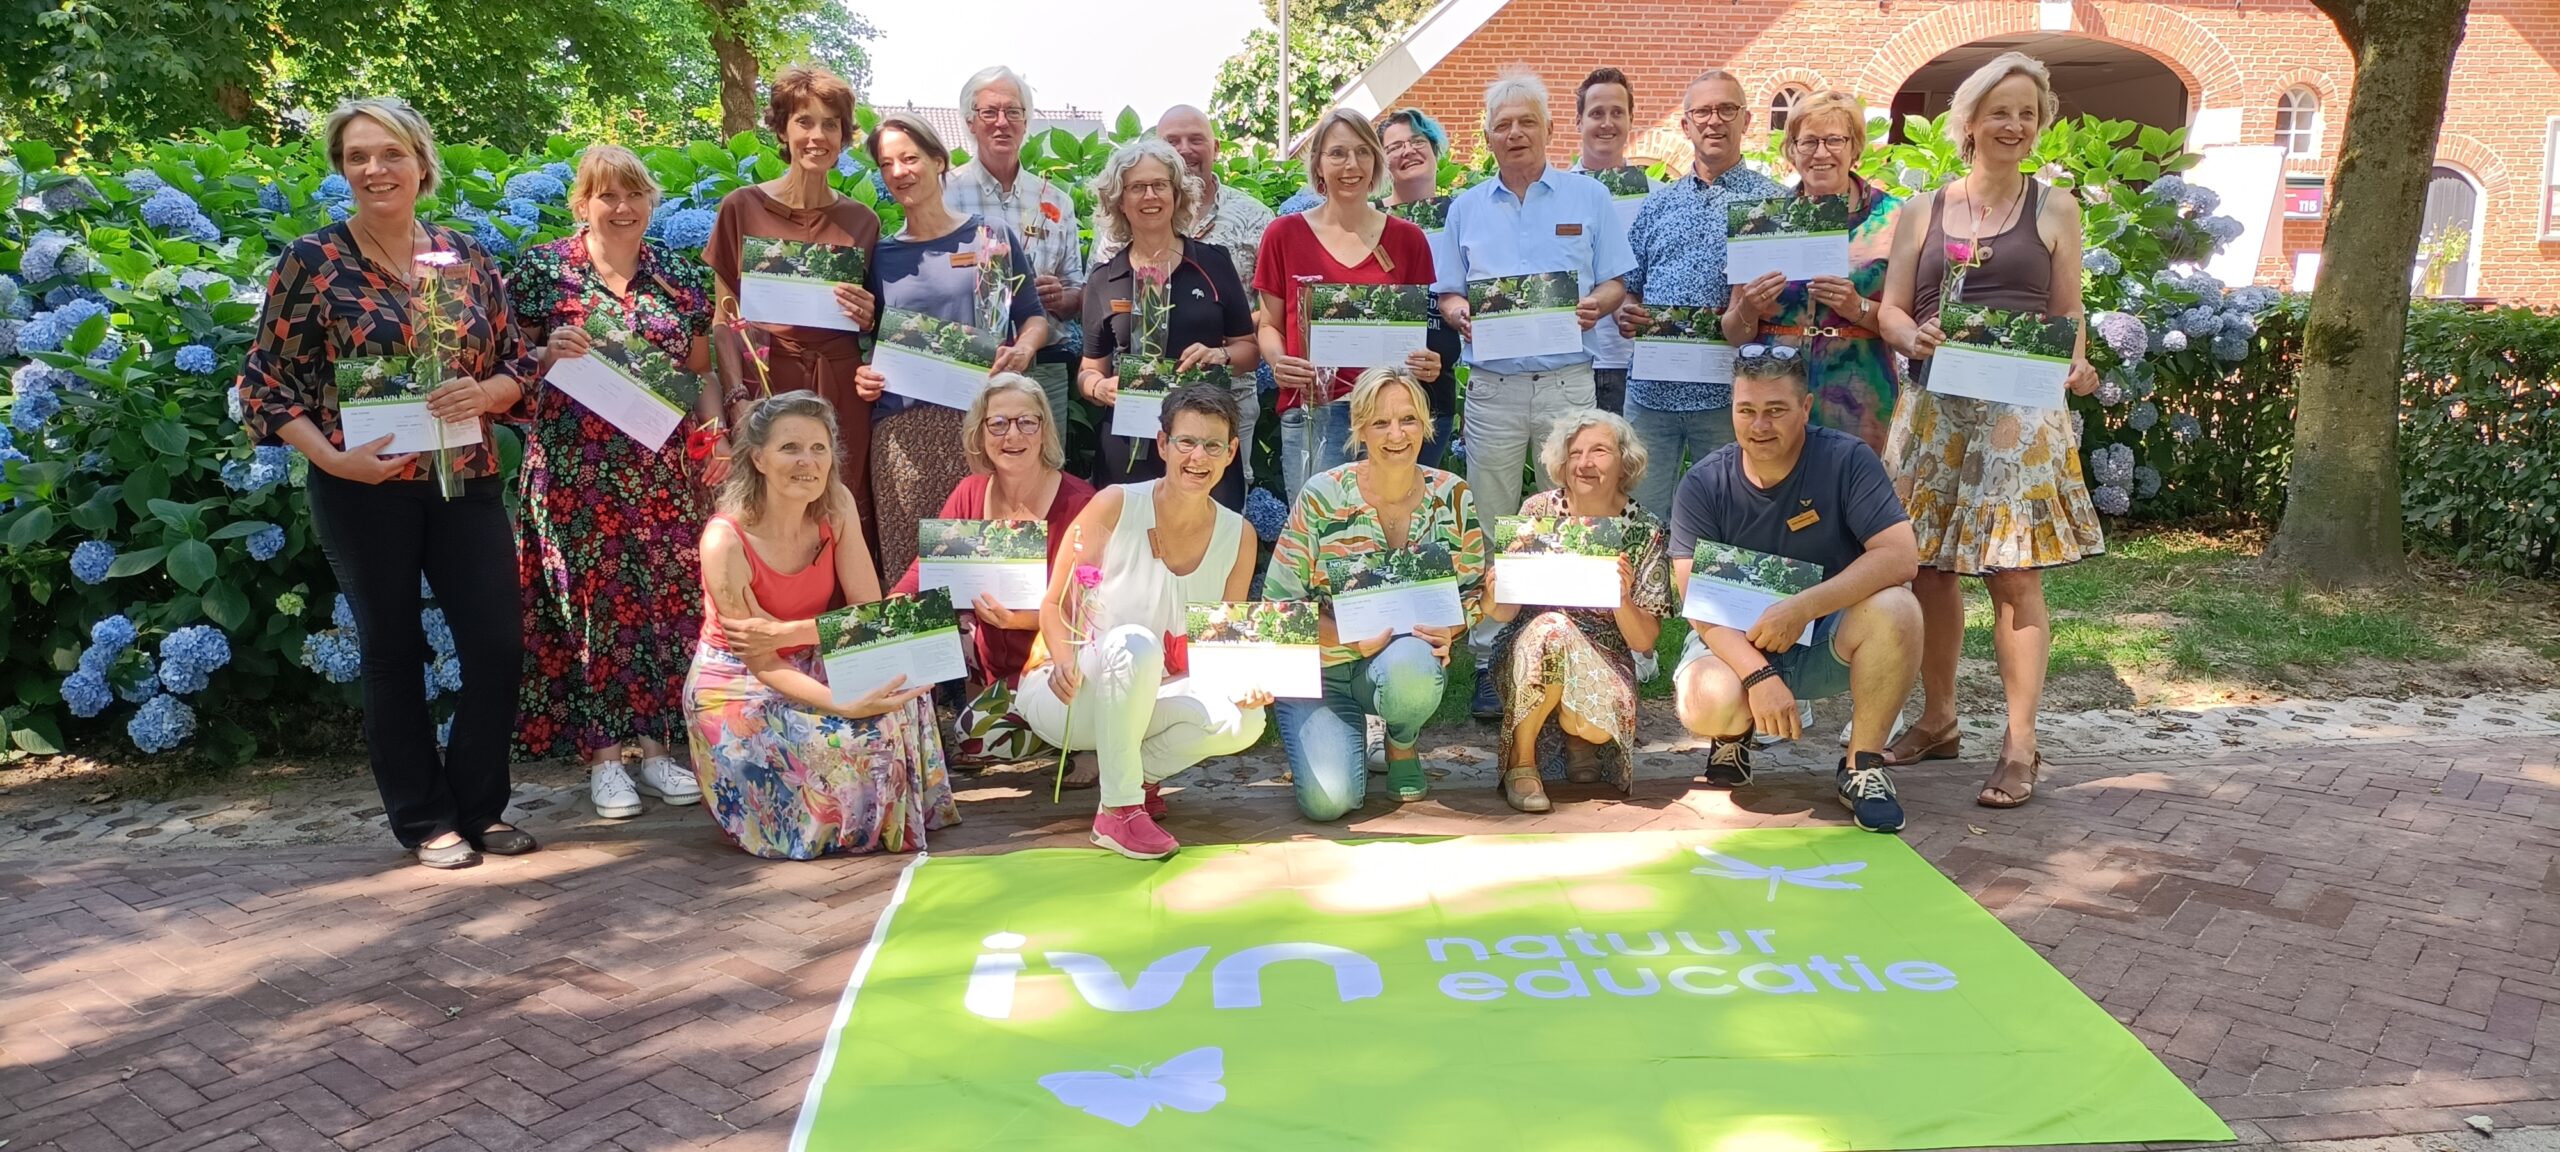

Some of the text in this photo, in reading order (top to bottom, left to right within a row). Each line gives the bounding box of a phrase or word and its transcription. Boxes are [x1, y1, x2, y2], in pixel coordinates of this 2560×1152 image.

[2298, 200, 2318, 212] 115
[591, 346, 607, 360] loma
[1946, 338, 1975, 348] Diploma
[1990, 345, 2028, 356] Natuurgids
[349, 396, 382, 404] Diploma
[400, 393, 427, 401] Natuur
[927, 554, 956, 562] Diploma
[831, 631, 914, 655] Diploma IVN Natuurgids
[1425, 927, 1776, 961] natuur
[964, 931, 1383, 1018] ivn
[1438, 954, 1960, 1001] educatie
